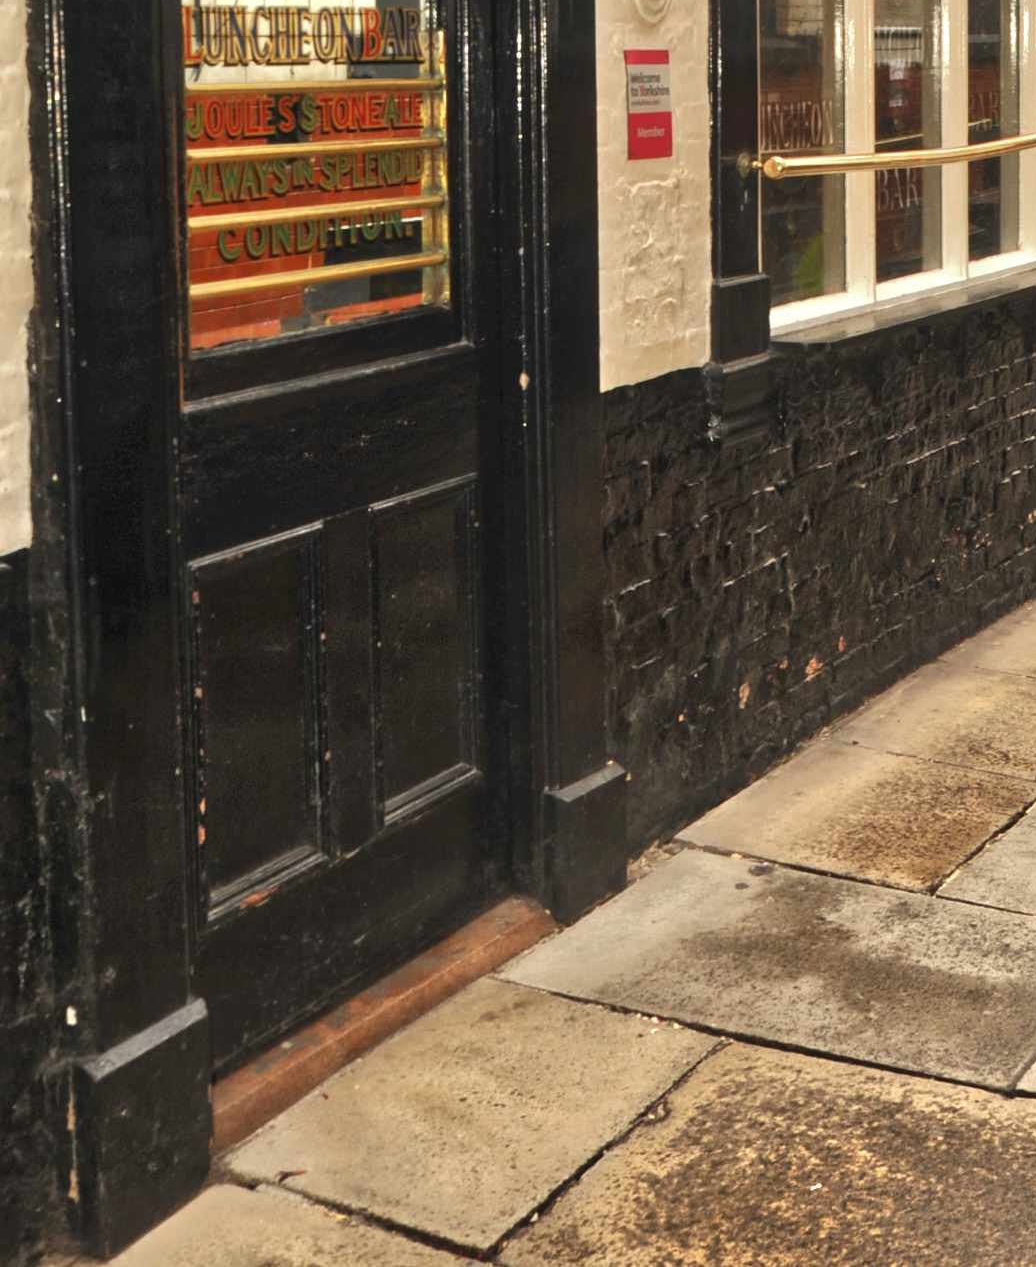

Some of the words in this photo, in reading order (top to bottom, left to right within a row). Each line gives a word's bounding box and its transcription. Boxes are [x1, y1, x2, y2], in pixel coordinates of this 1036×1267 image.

[181, 5, 361, 67] LUNCHEON
[361, 7, 425, 64] BAR
[299, 92, 386, 135] STONE
[379, 91, 425, 130] ALE
[188, 156, 290, 206] ALWAYS
[292, 155, 315, 189] IN
[319, 148, 425, 191] SPLENDID
